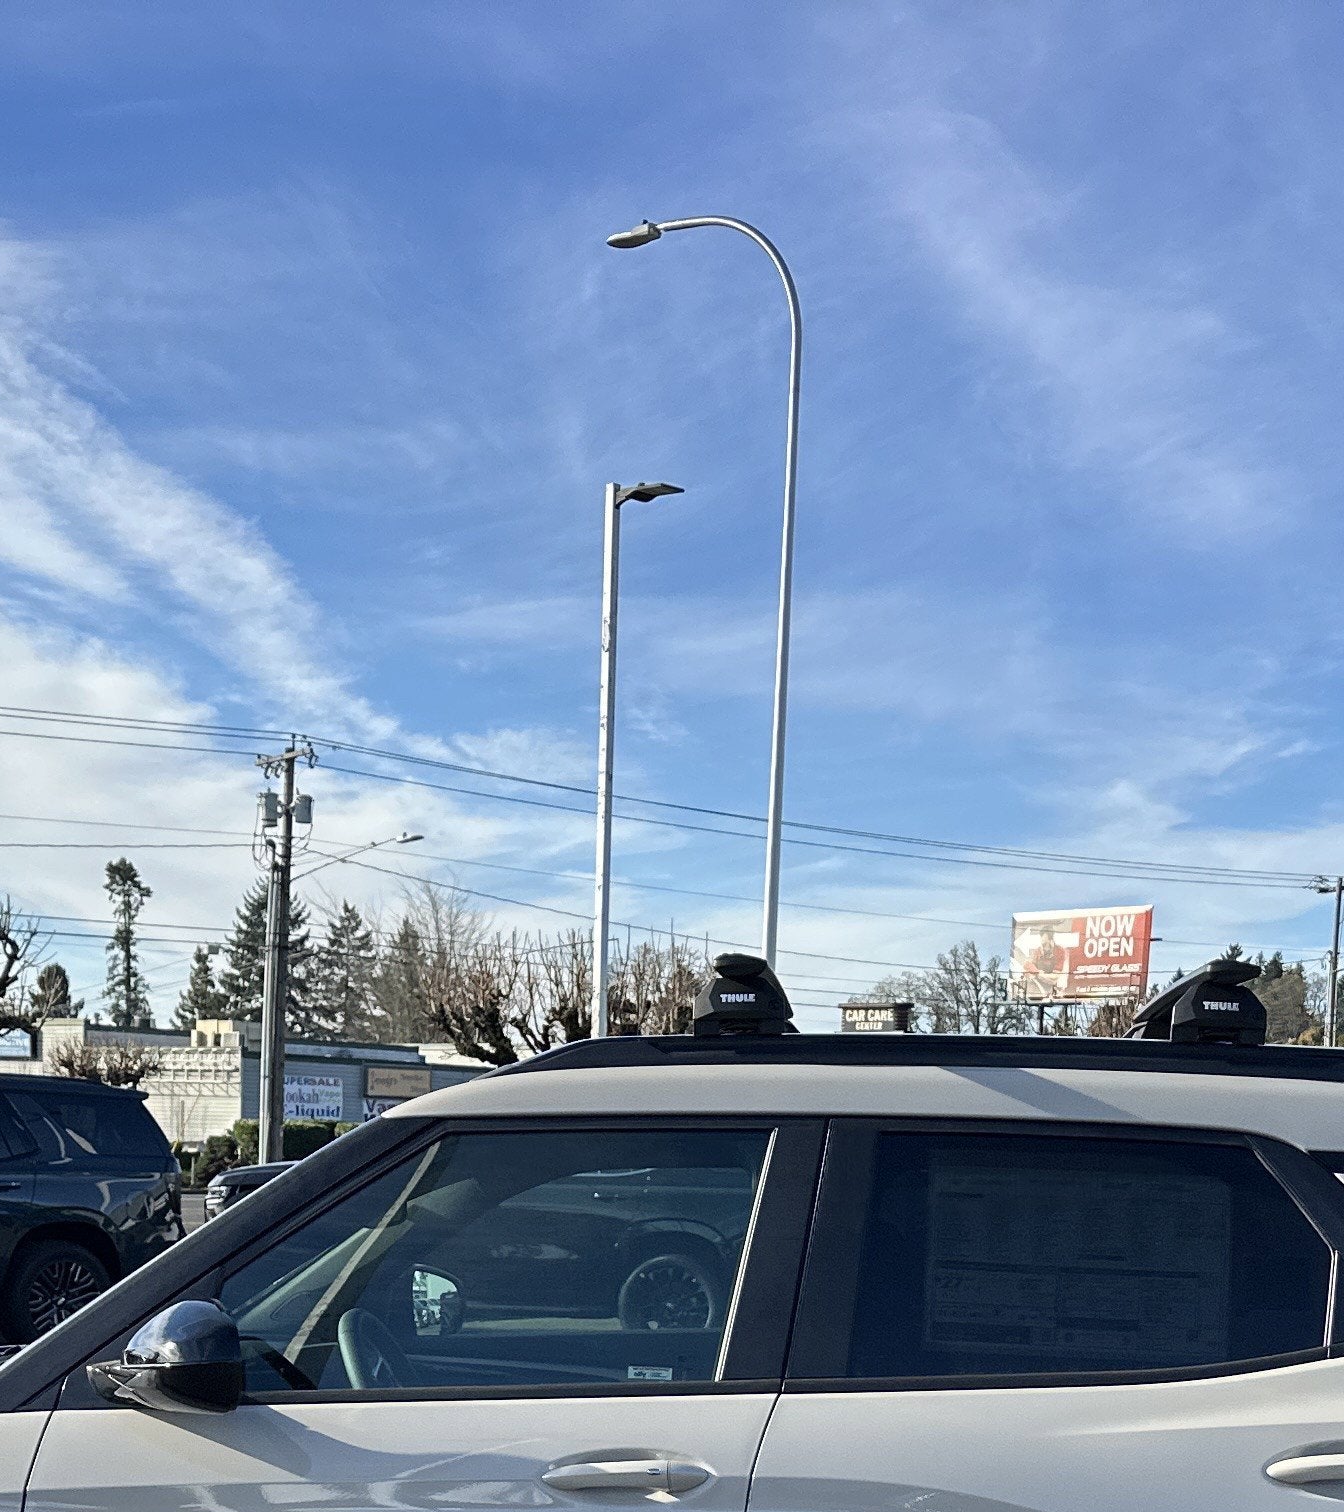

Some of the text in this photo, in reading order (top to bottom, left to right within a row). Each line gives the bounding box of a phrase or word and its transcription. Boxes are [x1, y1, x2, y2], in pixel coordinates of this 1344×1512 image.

[1086, 915, 1136, 938] NOW
[1084, 936, 1134, 958] OPEN
[720, 993, 756, 1003] THULE
[1202, 1001, 1240, 1011] THULE
[845, 1008, 894, 1021] CAR CARE
[855, 1021, 883, 1031] CENTER
[286, 1088, 318, 1104] ookah
